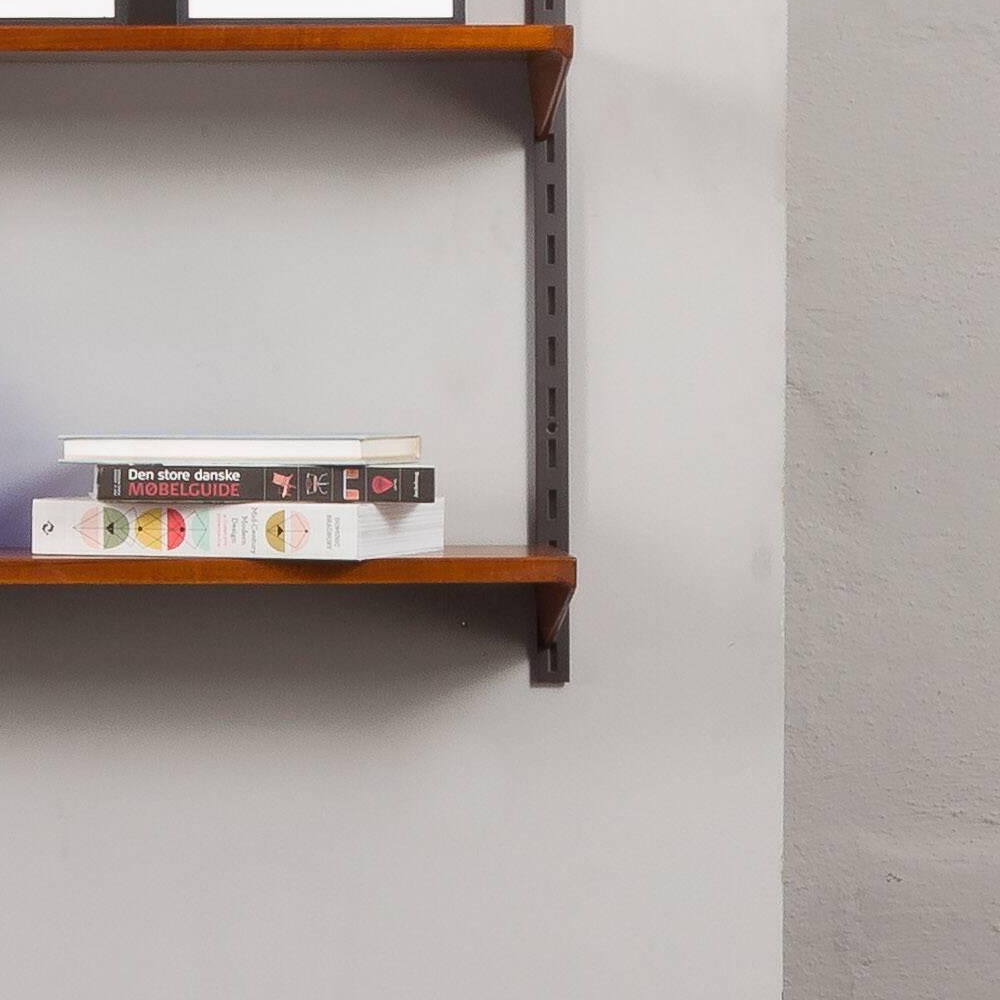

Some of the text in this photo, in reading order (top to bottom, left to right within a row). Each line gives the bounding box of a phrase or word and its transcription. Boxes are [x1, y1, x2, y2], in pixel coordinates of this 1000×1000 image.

[128, 469, 240, 481] Den store danske
[128, 482, 240, 497] MØBELGUIDE
